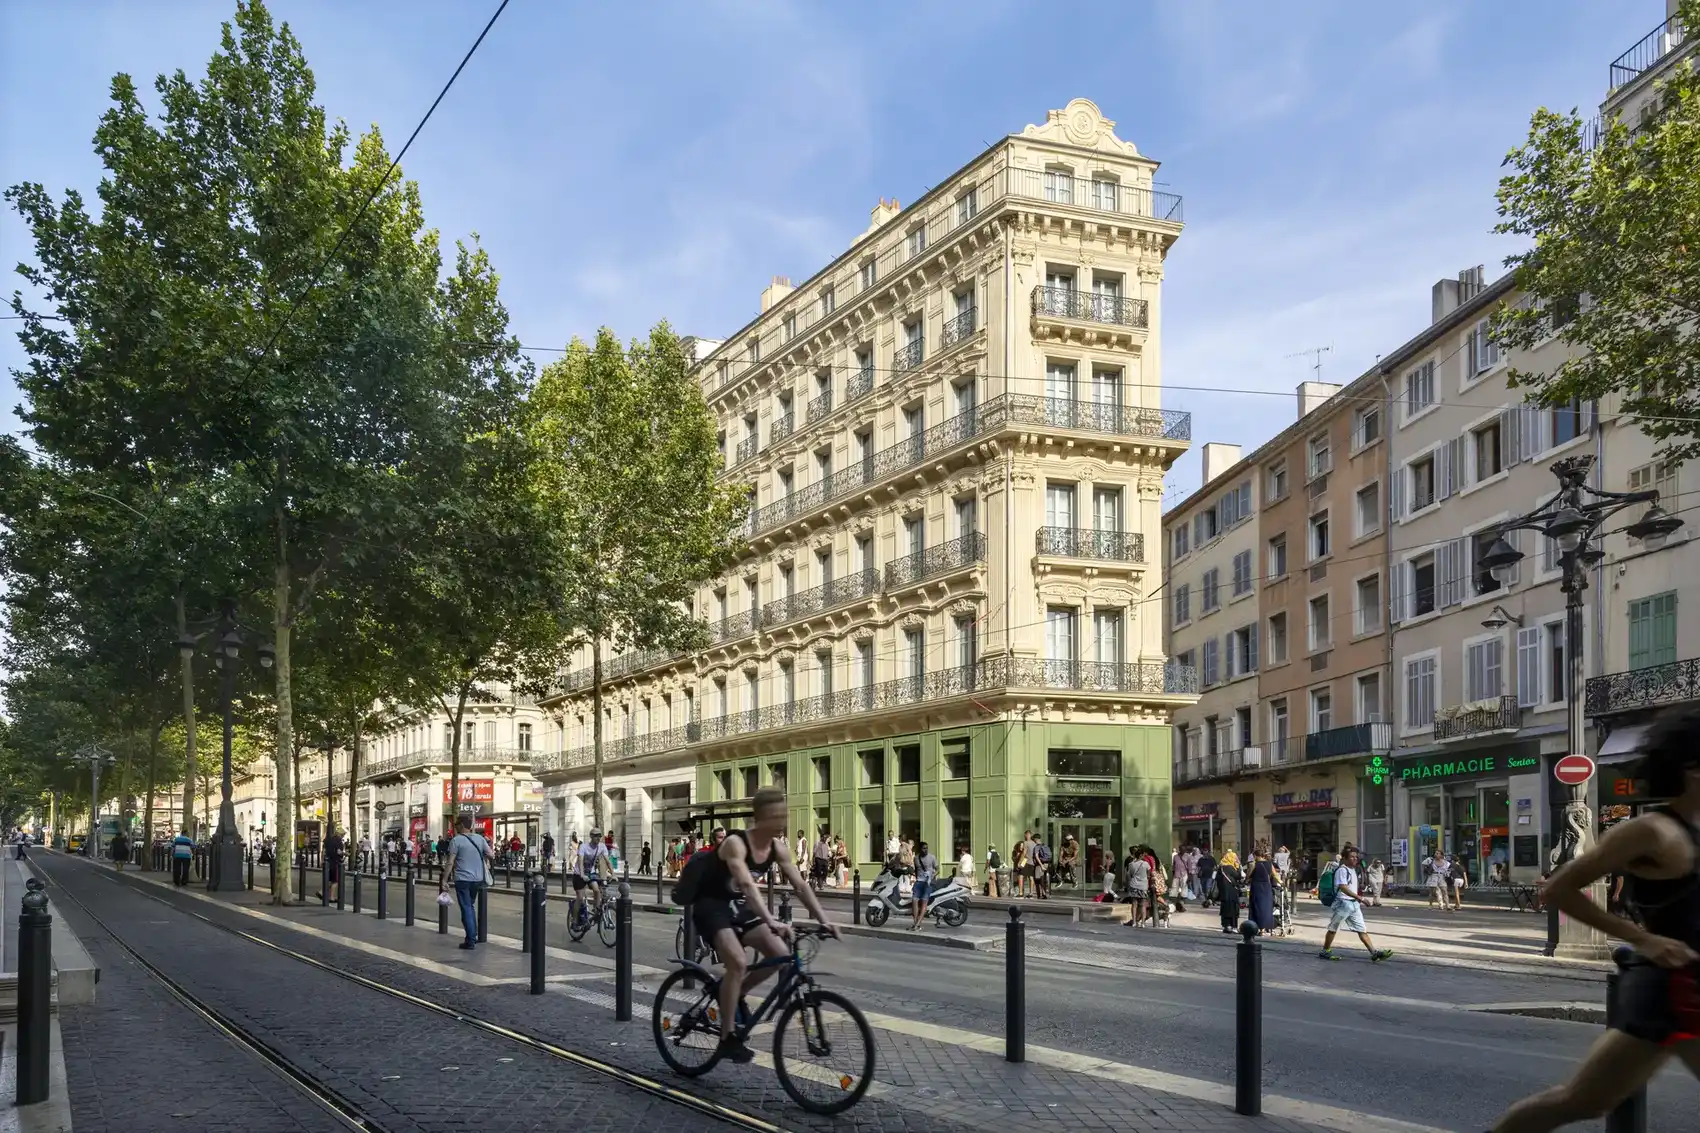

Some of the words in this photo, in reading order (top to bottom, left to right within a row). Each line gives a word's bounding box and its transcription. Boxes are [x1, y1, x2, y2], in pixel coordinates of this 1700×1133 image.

[1402, 757, 1495, 780] PHARMACIE
[1507, 757, 1537, 768] Senior
[457, 803, 482, 813] iery
[523, 803, 544, 812] Pie
